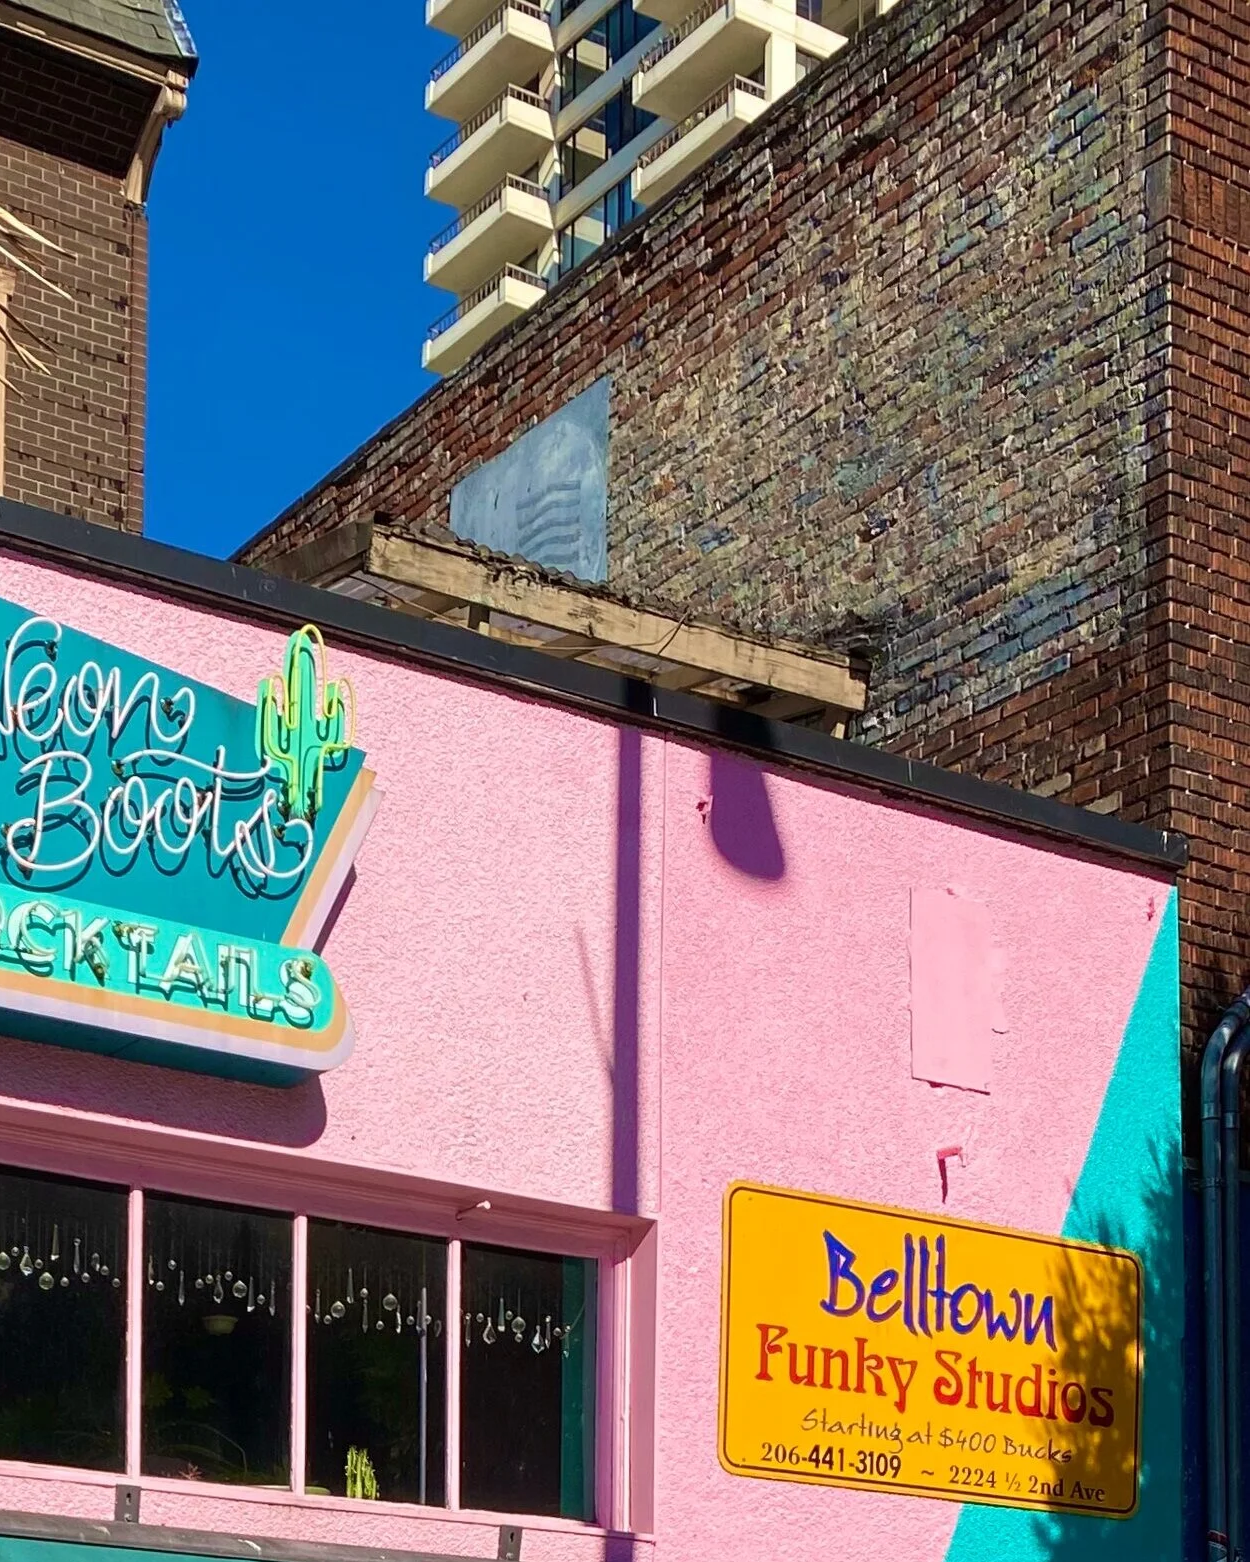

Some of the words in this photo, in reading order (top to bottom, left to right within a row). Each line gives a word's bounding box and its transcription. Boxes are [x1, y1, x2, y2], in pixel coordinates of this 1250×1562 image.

[7, 746, 313, 878] Boots
[820, 1229, 1057, 1352] Belltown
[755, 1323, 918, 1414] Funky
[933, 1349, 1115, 1428] Studios
[760, 1441, 902, 1479] 206-441-3109
[949, 1465, 997, 1490] 2224
[1028, 1475, 1065, 1498] 2nd
[1070, 1480, 1106, 1503] Ave
[801, 1408, 903, 1453] Starting
[906, 1430, 933, 1446] at
[938, 1427, 996, 1455] $400
[1003, 1436, 1073, 1464] Bucks
